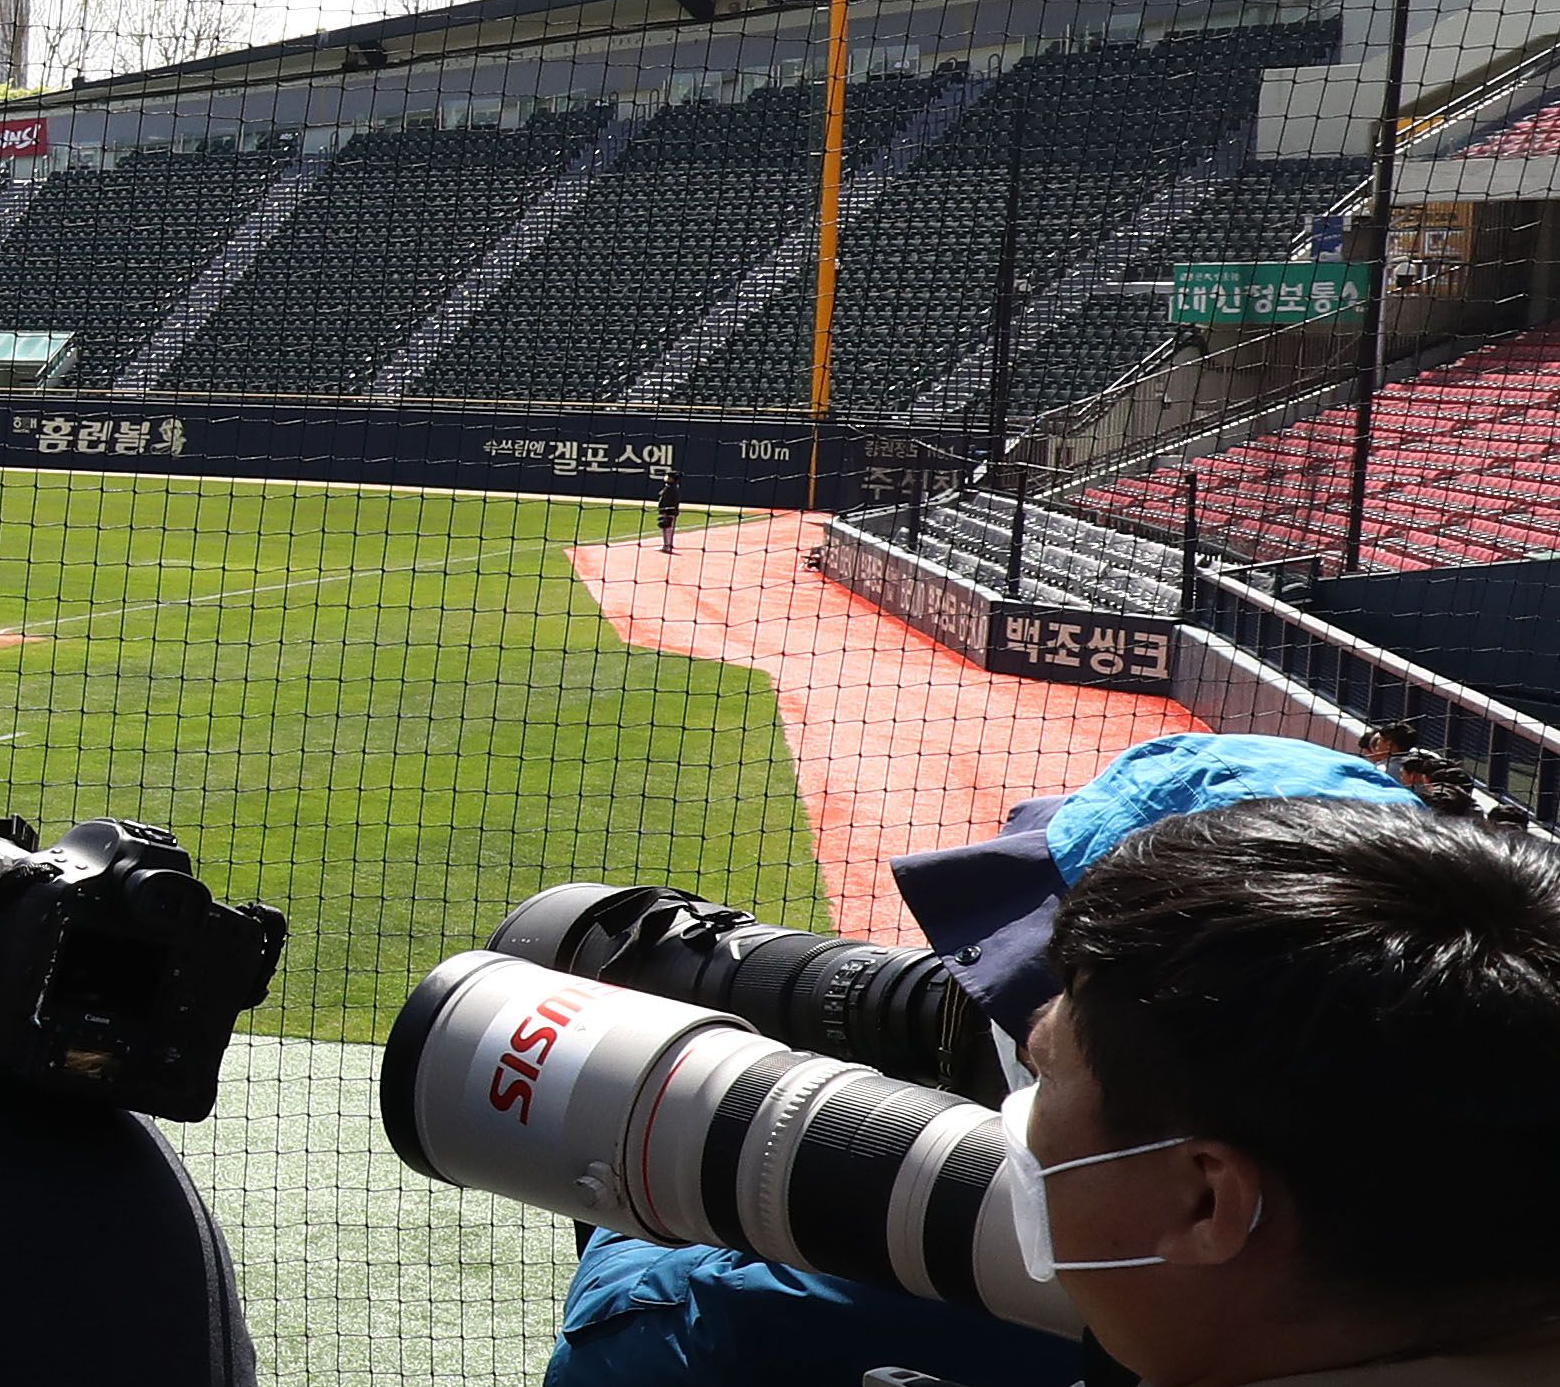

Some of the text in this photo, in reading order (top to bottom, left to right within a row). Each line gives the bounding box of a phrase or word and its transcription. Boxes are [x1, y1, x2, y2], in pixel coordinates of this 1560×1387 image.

[37, 417, 151, 455] 홈런볼
[482, 438, 674, 480] 속쓰림엔 겔포스엠
[1005, 615, 1171, 679] 백조씽크
[84, 1013, 111, 1027] Canon
